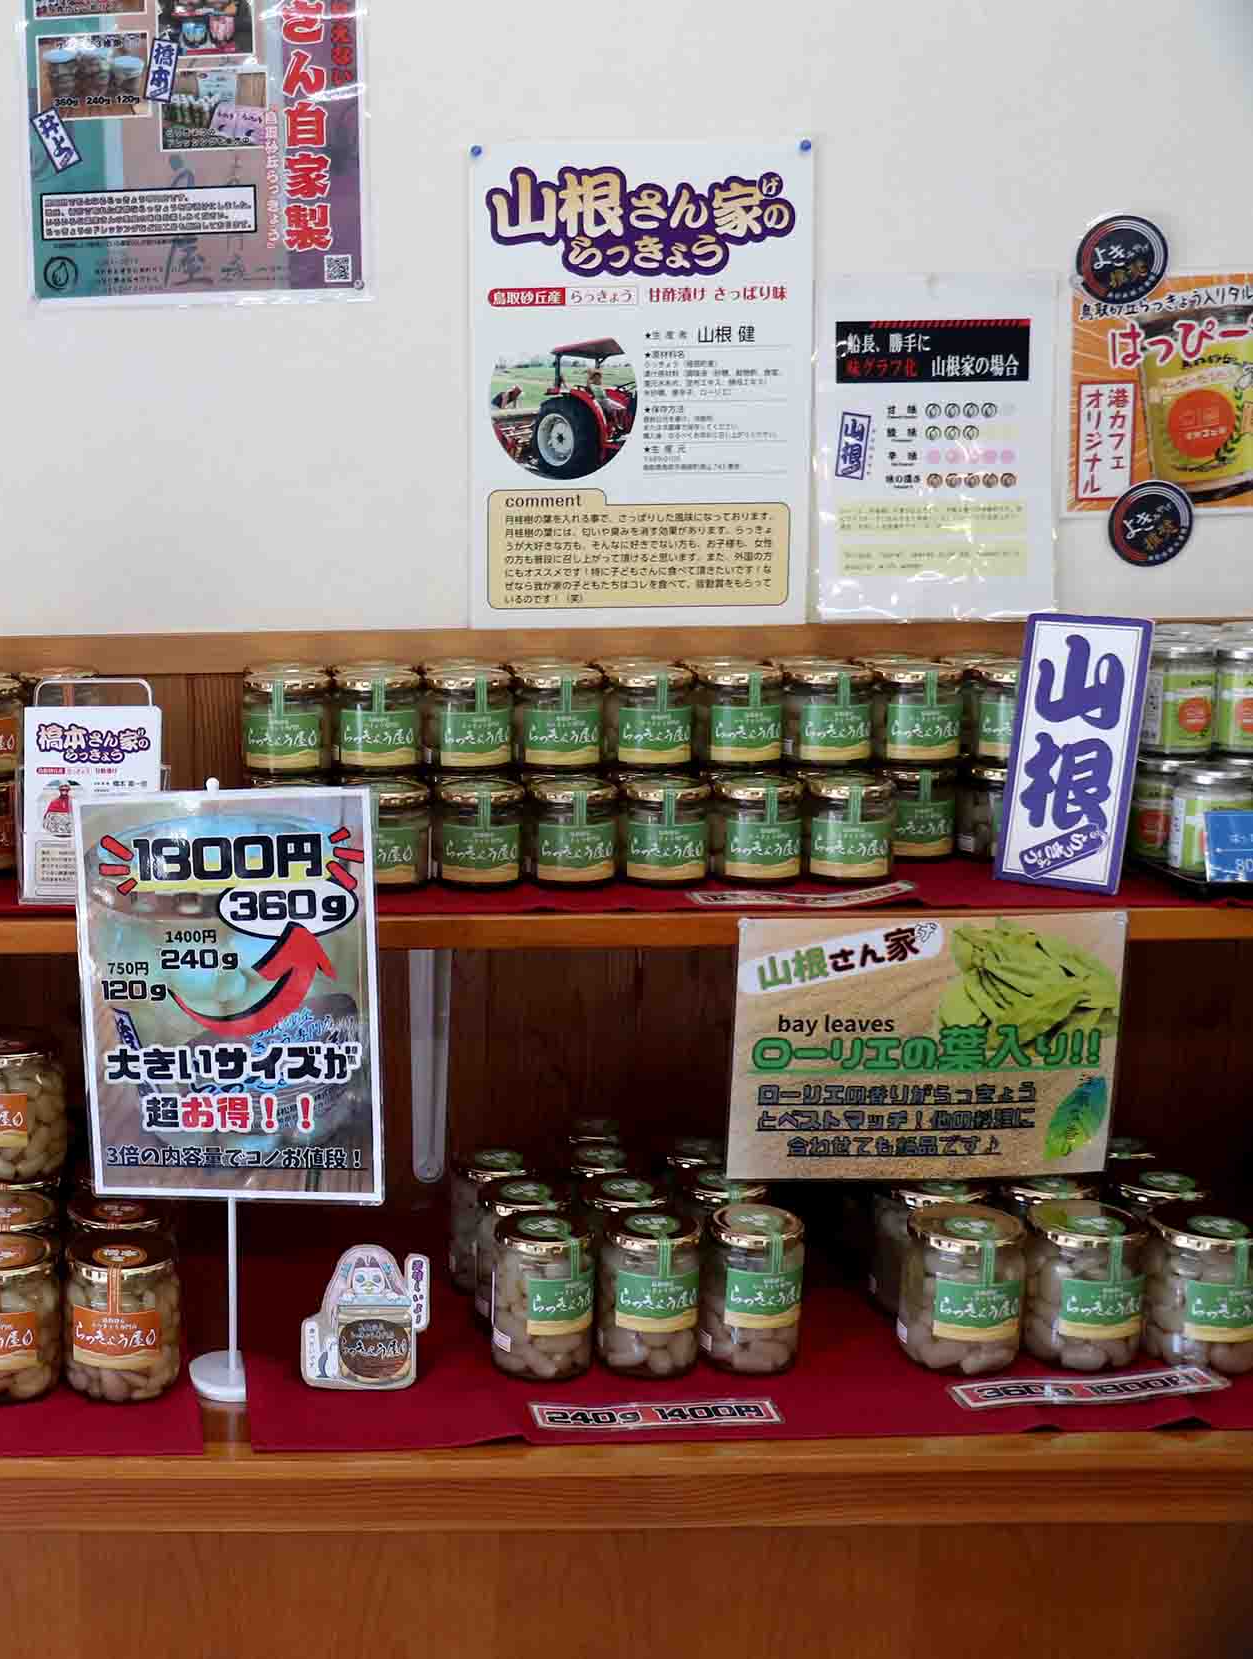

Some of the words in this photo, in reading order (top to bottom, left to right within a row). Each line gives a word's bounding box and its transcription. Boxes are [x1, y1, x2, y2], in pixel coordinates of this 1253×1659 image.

[489, 169, 793, 240] 山根さん家の
[568, 235, 725, 270] らっきょう
[492, 290, 562, 305] 鳥取砂丘産
[570, 289, 635, 304] らっきょう
[649, 287, 707, 304] 甘酢漬け
[714, 286, 787, 301] さっぱり味
[698, 326, 731, 343] 山根
[738, 326, 755, 343] 健
[1111, 320, 1253, 368] はっぴー
[931, 354, 1020, 377] 山根家の場合
[1082, 389, 1105, 494] オリジナル
[1107, 388, 1131, 470] 港カフェ
[505, 494, 582, 508] comment
[37, 724, 150, 751] 橋本さん家の
[1020, 634, 1125, 830] 山根
[64, 750, 123, 762] らっきょう
[229, 889, 347, 922] 360g
[165, 929, 217, 944] 1400円
[108, 961, 149, 976] 750円
[161, 949, 238, 970] 240g
[756, 927, 921, 990] 山根さん家
[102, 979, 167, 1001] 120g
[778, 1015, 818, 1034] bay
[825, 1014, 895, 1033] leaves
[752, 1025, 1101, 1070] ローリエの葉入り!!
[108, 1045, 358, 1080] 大きいサイズが
[758, 1081, 1035, 1105] ローリエの香りがらっきょう
[147, 1096, 314, 1129] 超お得！！
[106, 1146, 362, 1169] 3倍の内容量でコノお値段！
[75, 1321, 140, 1348] らっきょう屋
[547, 1410, 641, 1425] 240g
[652, 1404, 765, 1422] 1400円
